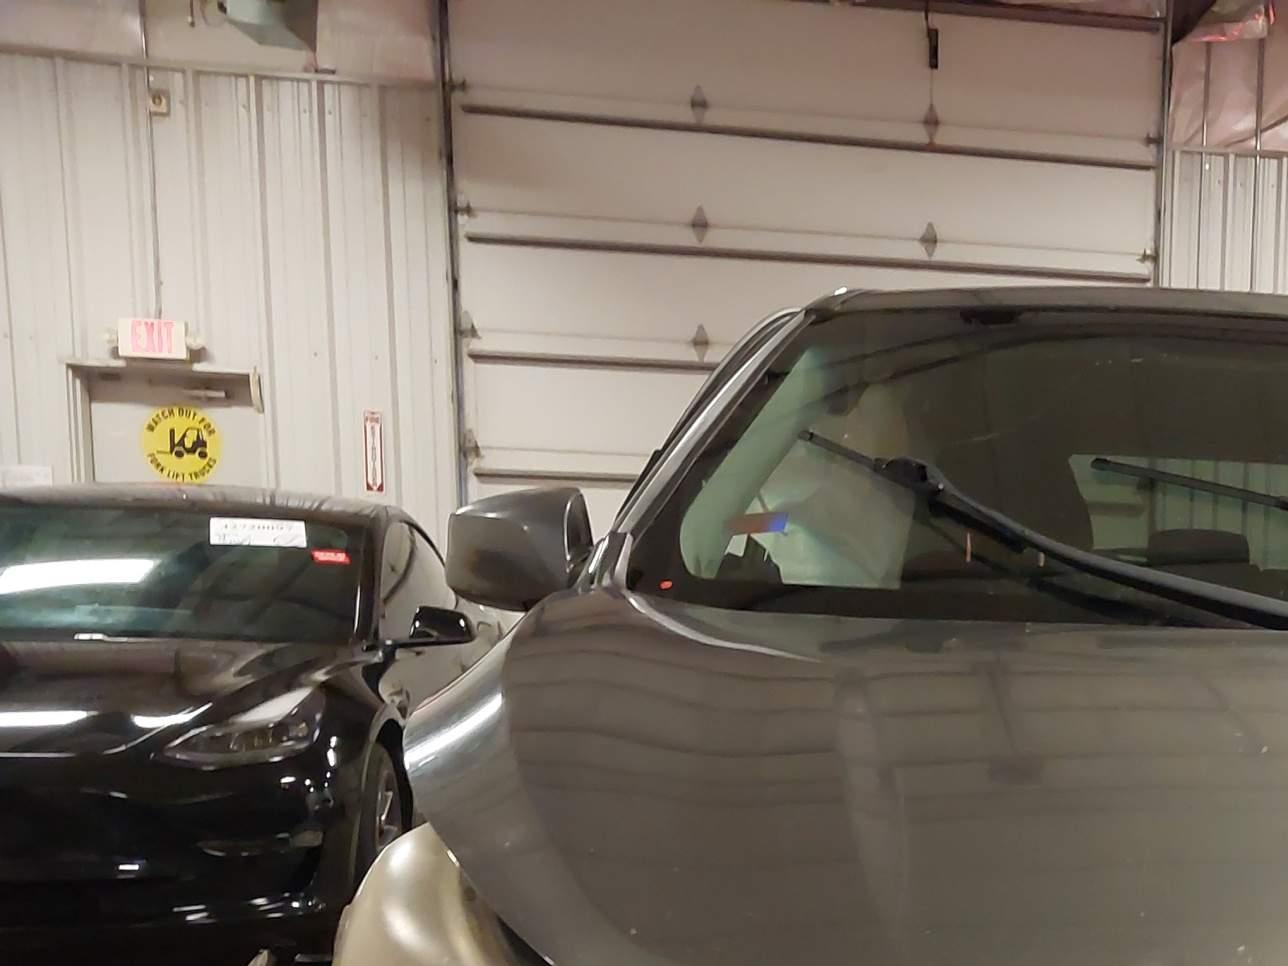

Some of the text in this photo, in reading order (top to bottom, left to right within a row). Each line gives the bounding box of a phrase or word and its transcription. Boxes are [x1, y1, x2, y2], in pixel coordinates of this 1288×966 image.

[131, 321, 175, 352] EXIT
[147, 408, 216, 436] WATCH OUT FOR
[147, 452, 217, 482] FORK LIFT TRUCKS
